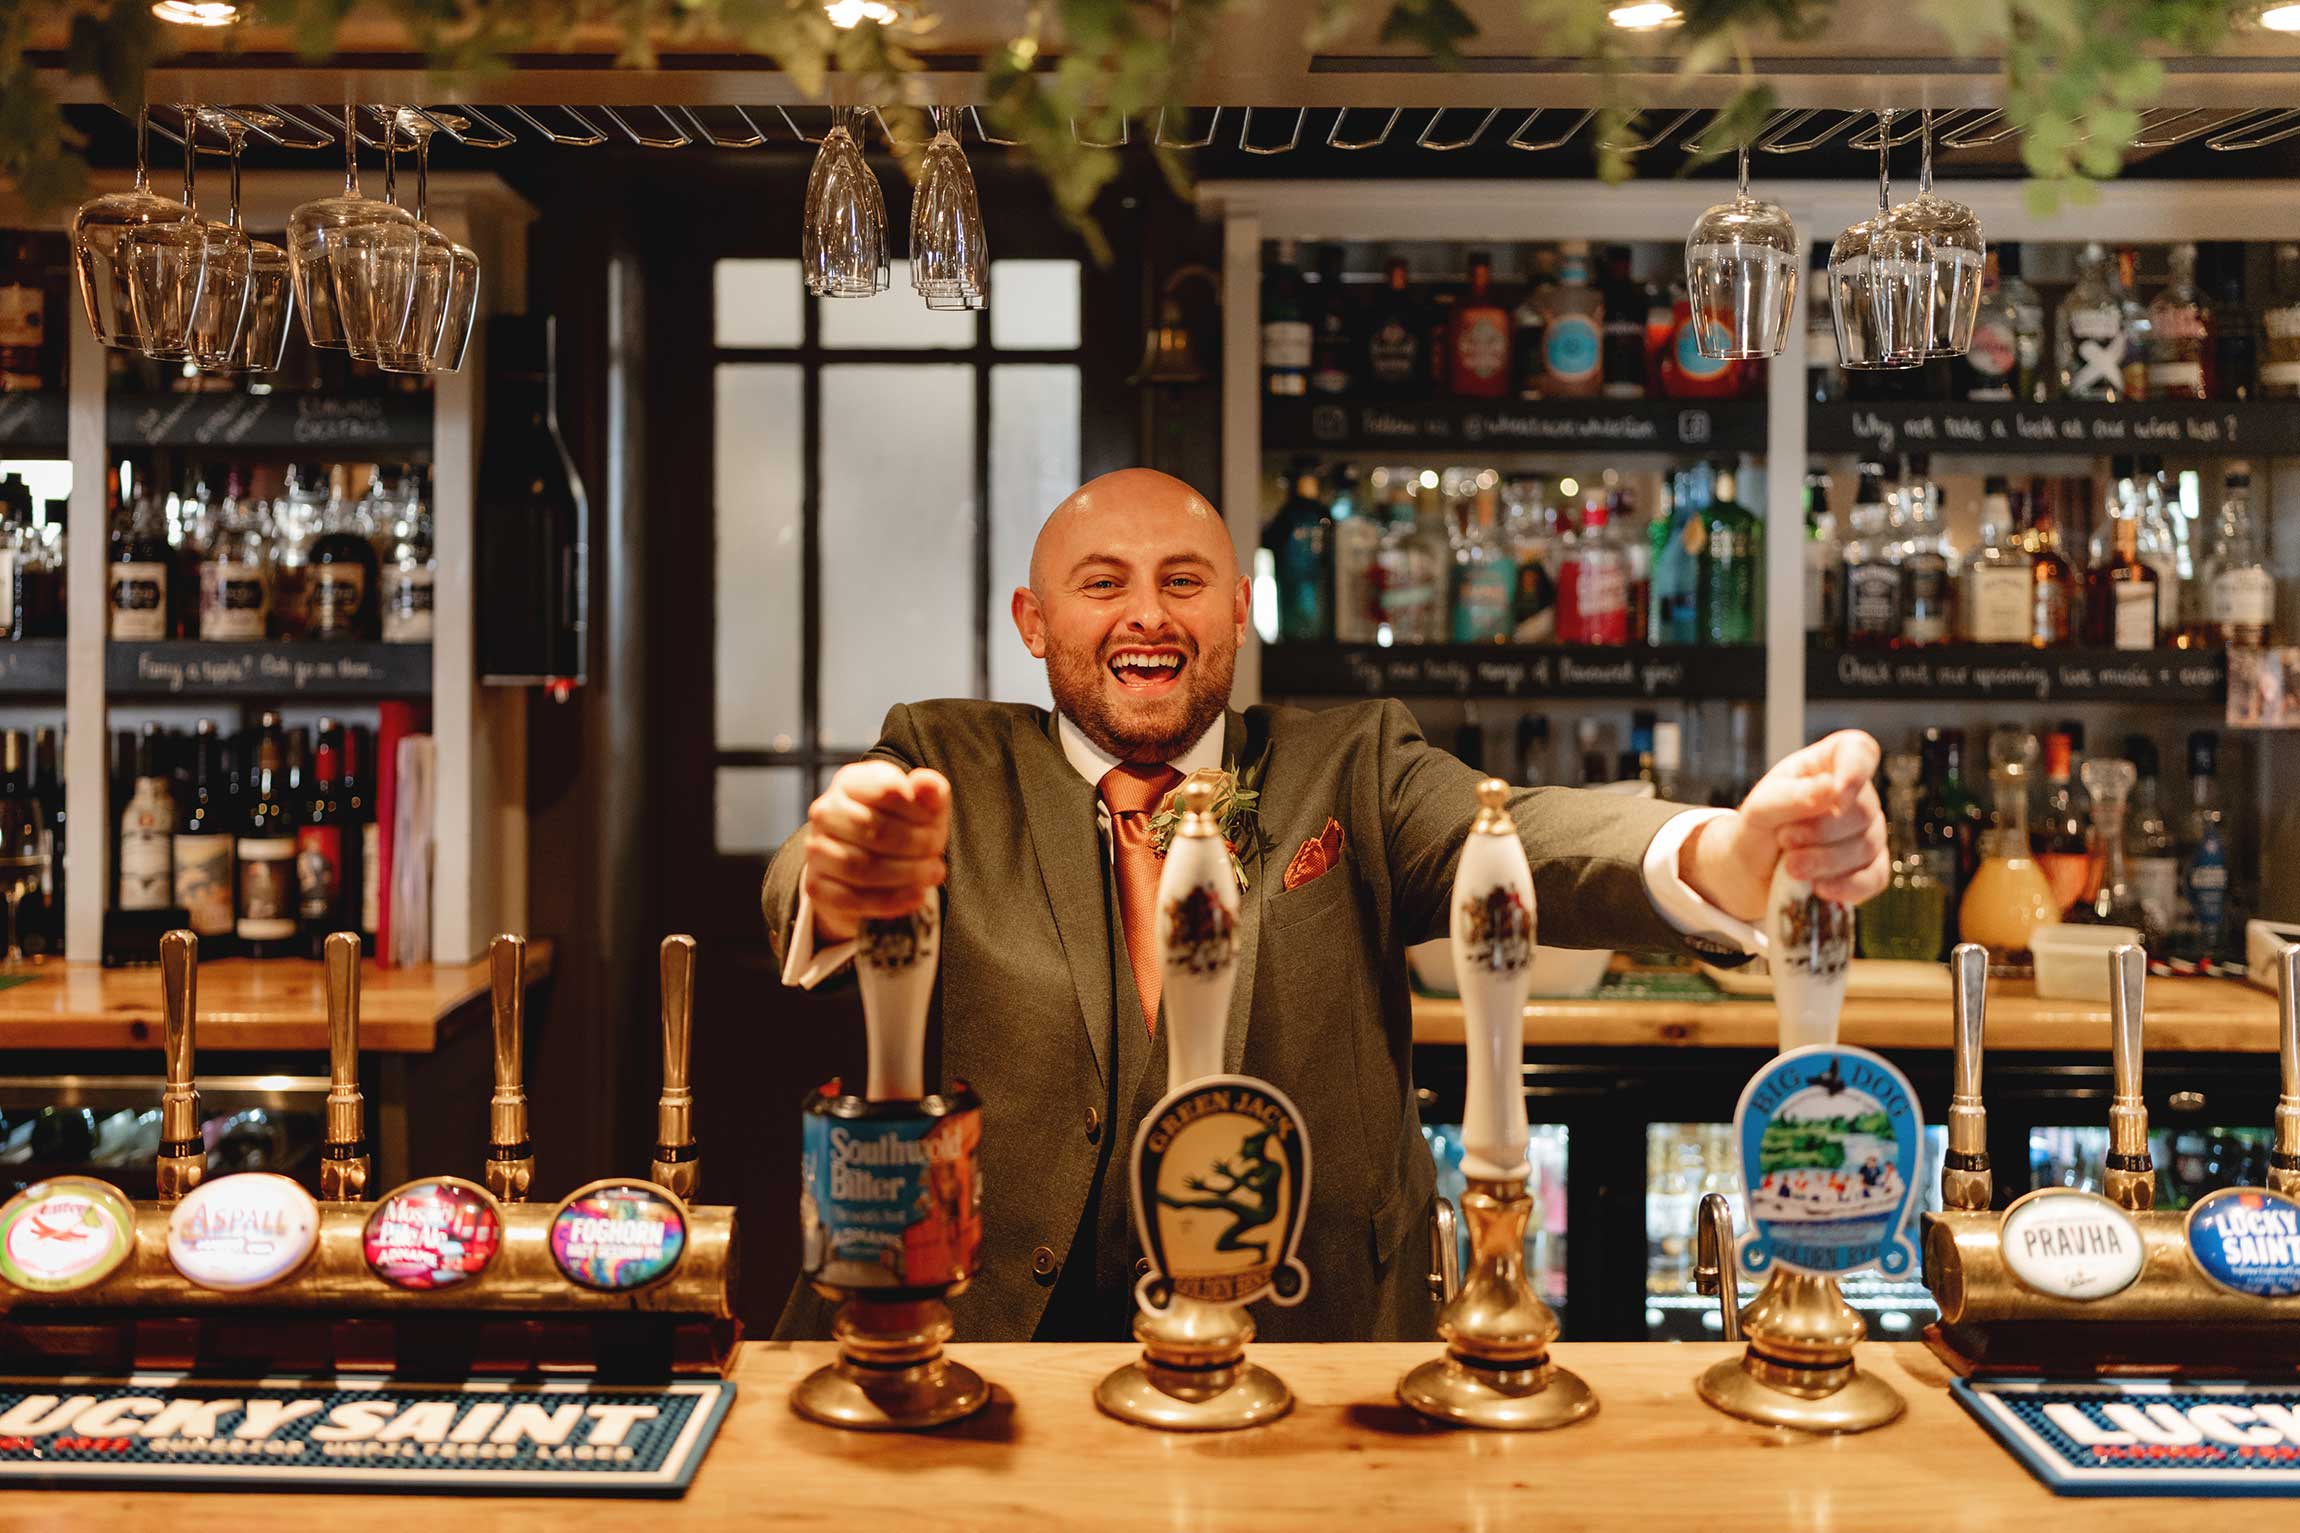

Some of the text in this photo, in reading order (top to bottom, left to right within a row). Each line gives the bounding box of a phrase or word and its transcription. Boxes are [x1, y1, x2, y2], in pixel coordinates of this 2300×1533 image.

[1852, 412, 1895, 453] Why
[1904, 416, 1934, 438] not
[1944, 415, 1984, 440] take
[1991, 418, 2007, 438] a
[2016, 412, 2056, 439] look
[2061, 417, 2085, 438] at
[2092, 418, 2125, 438] our
[2134, 416, 2180, 439] wine
[138, 651, 184, 692] Fancy
[185, 661, 199, 680] a
[1837, 652, 1890, 686] Check
[1896, 664, 1928, 685] out
[1935, 664, 1967, 685] our
[1972, 662, 2049, 698] upcoming
[2058, 664, 2092, 686] live
[2099, 662, 2151, 686] music
[1751, 1063, 1911, 1118] BIG DOG
[1148, 1090, 1295, 1153] GREEN JACK
[830, 1124, 962, 1165] Southwold
[831, 1159, 906, 1201] Bitter
[191, 1202, 287, 1236] ASPALL
[570, 1216, 665, 1246] FOGHORN
[2215, 1209, 2298, 1239] LUCKY
[2024, 1224, 2123, 1258] PRAVHA
[2222, 1235, 2300, 1266] SAINT
[310, 1399, 660, 1447] SAINT
